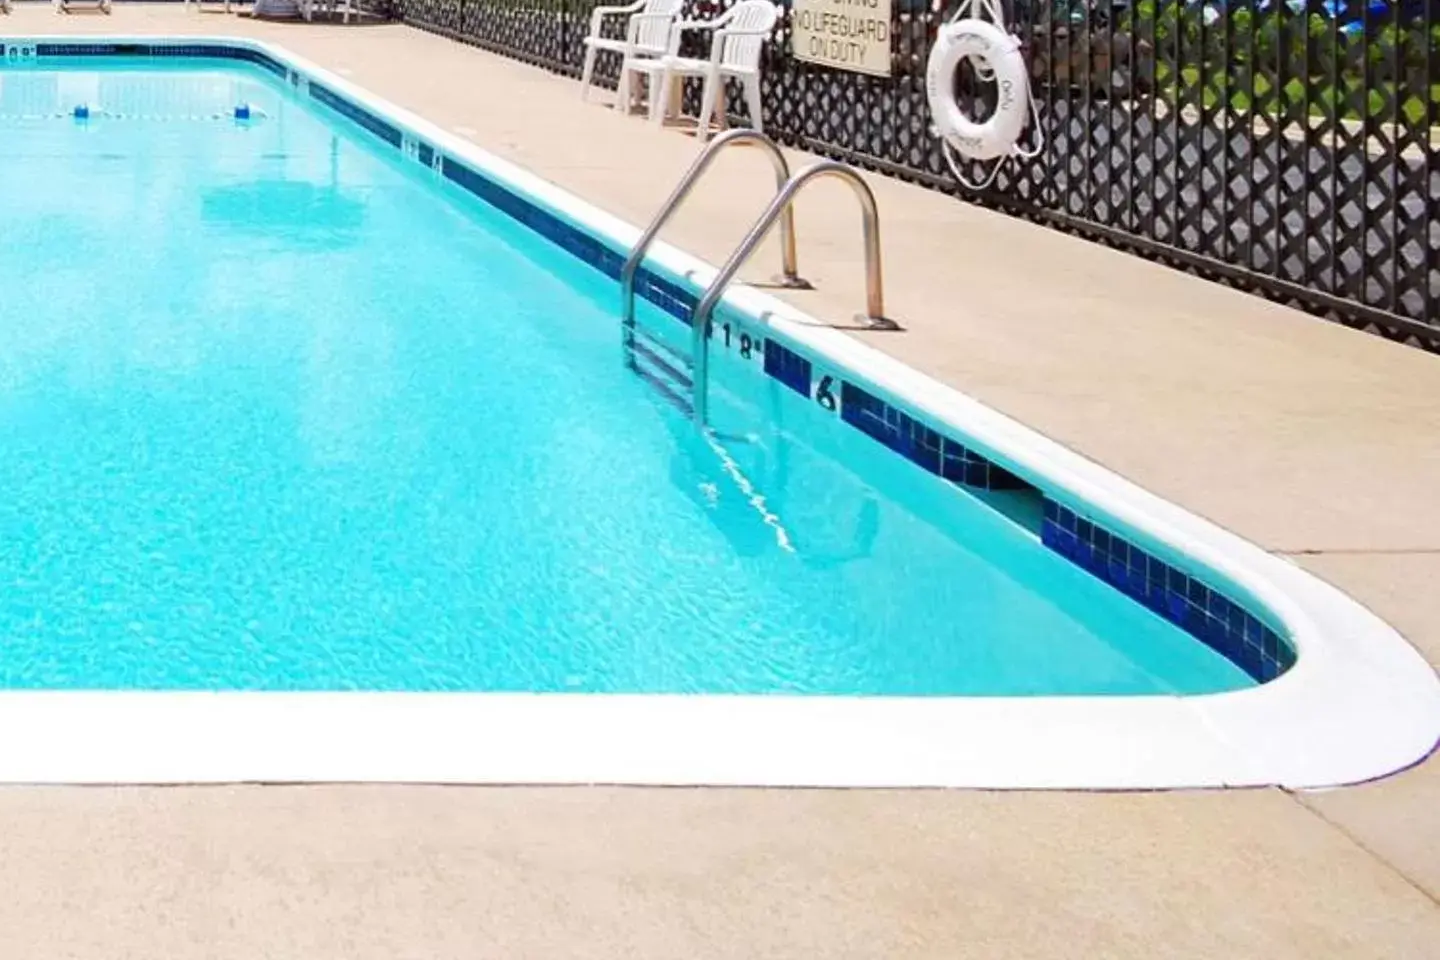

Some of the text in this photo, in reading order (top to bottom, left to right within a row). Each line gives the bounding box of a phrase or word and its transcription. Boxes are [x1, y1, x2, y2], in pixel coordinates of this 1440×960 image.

[793, 8, 888, 43] NO LIFEGUARD
[810, 35, 867, 65] ON DUTY
[816, 375, 836, 412] 6
